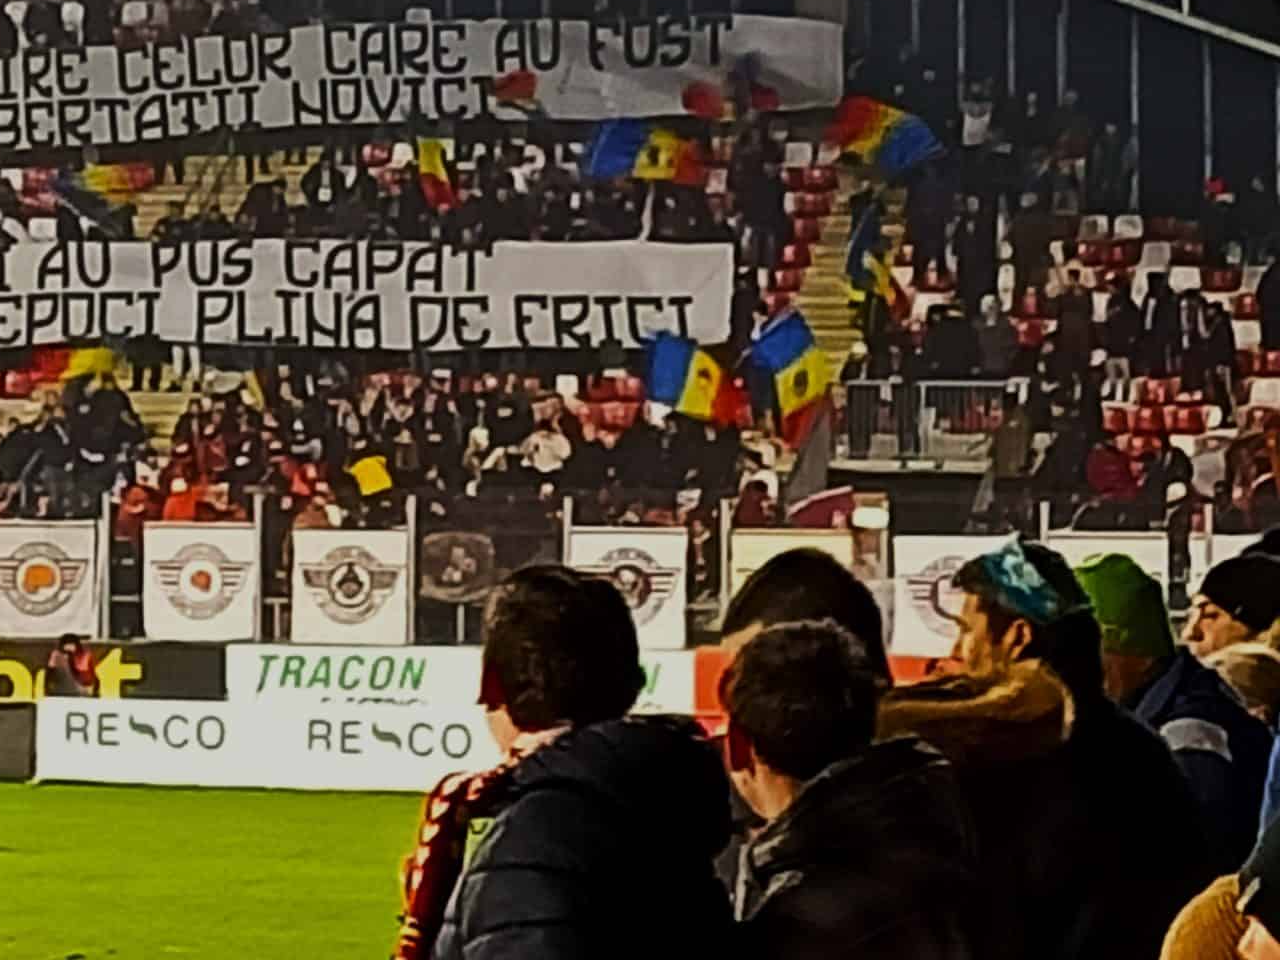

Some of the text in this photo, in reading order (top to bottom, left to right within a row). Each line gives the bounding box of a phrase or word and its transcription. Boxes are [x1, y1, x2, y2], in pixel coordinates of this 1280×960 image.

[118, 33, 291, 95] CELOR
[324, 22, 467, 75] CARE
[495, 19, 560, 72] AU
[588, 15, 732, 71] FOST
[38, 241, 111, 288] AU
[152, 240, 253, 288] PUS
[285, 242, 493, 292] CAPAT
[410, 295, 490, 350] DE
[514, 295, 692, 348] FRICI
[256, 654, 426, 694] TRACON
